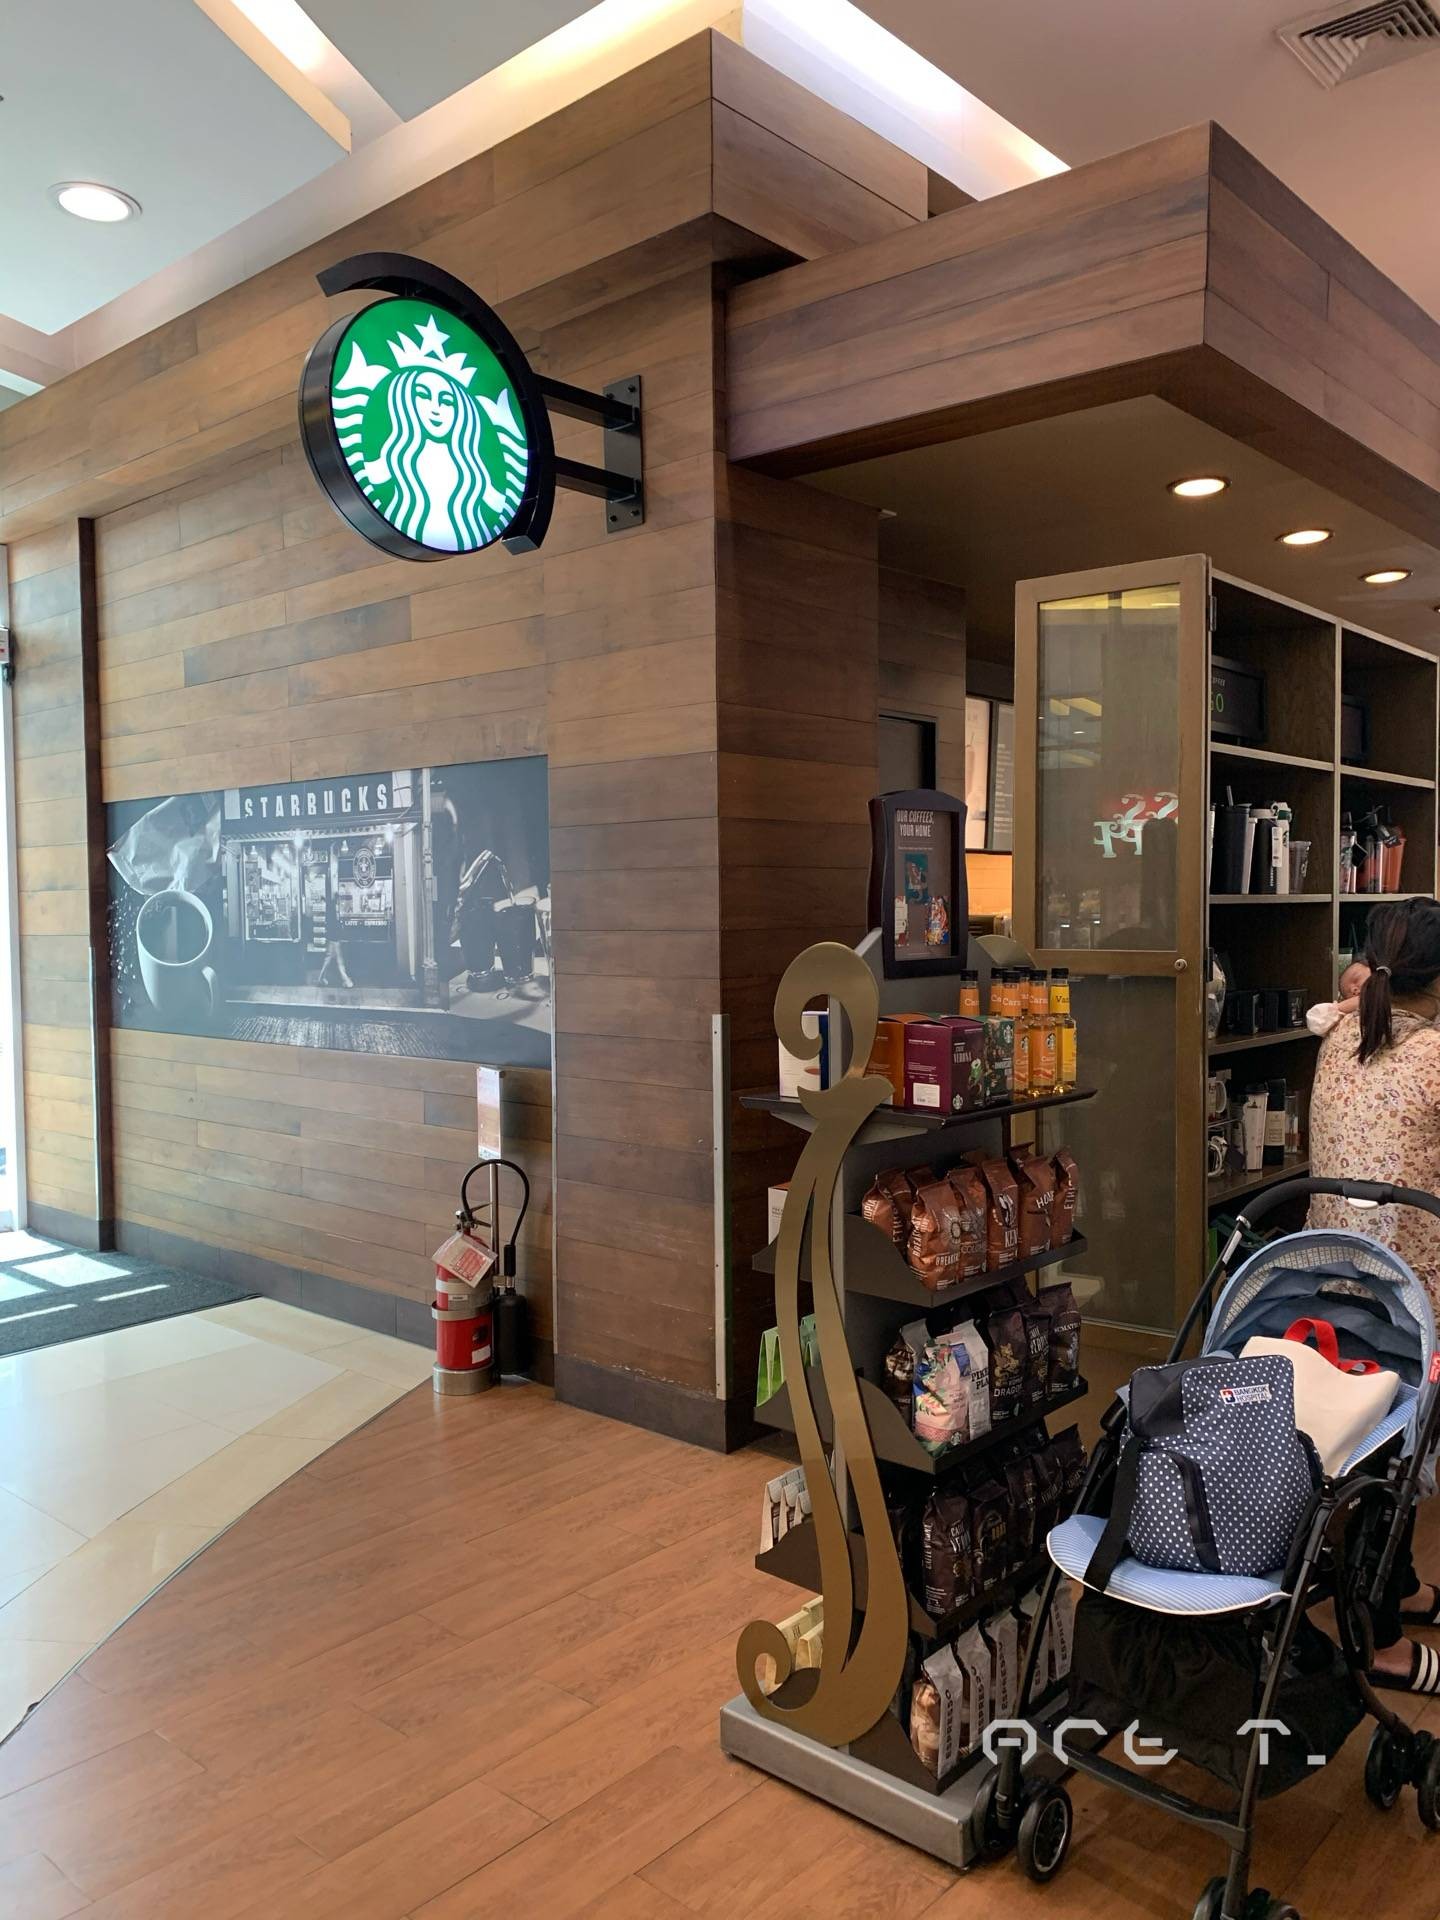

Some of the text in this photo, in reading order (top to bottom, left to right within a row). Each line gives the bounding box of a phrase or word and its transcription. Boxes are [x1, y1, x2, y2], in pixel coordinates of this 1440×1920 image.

[244, 783, 387, 818] STARBUCKS
[896, 809, 908, 822] OUR
[900, 824, 931, 837] YOUR HOME
[1233, 1386, 1268, 1396] BANGKOK
